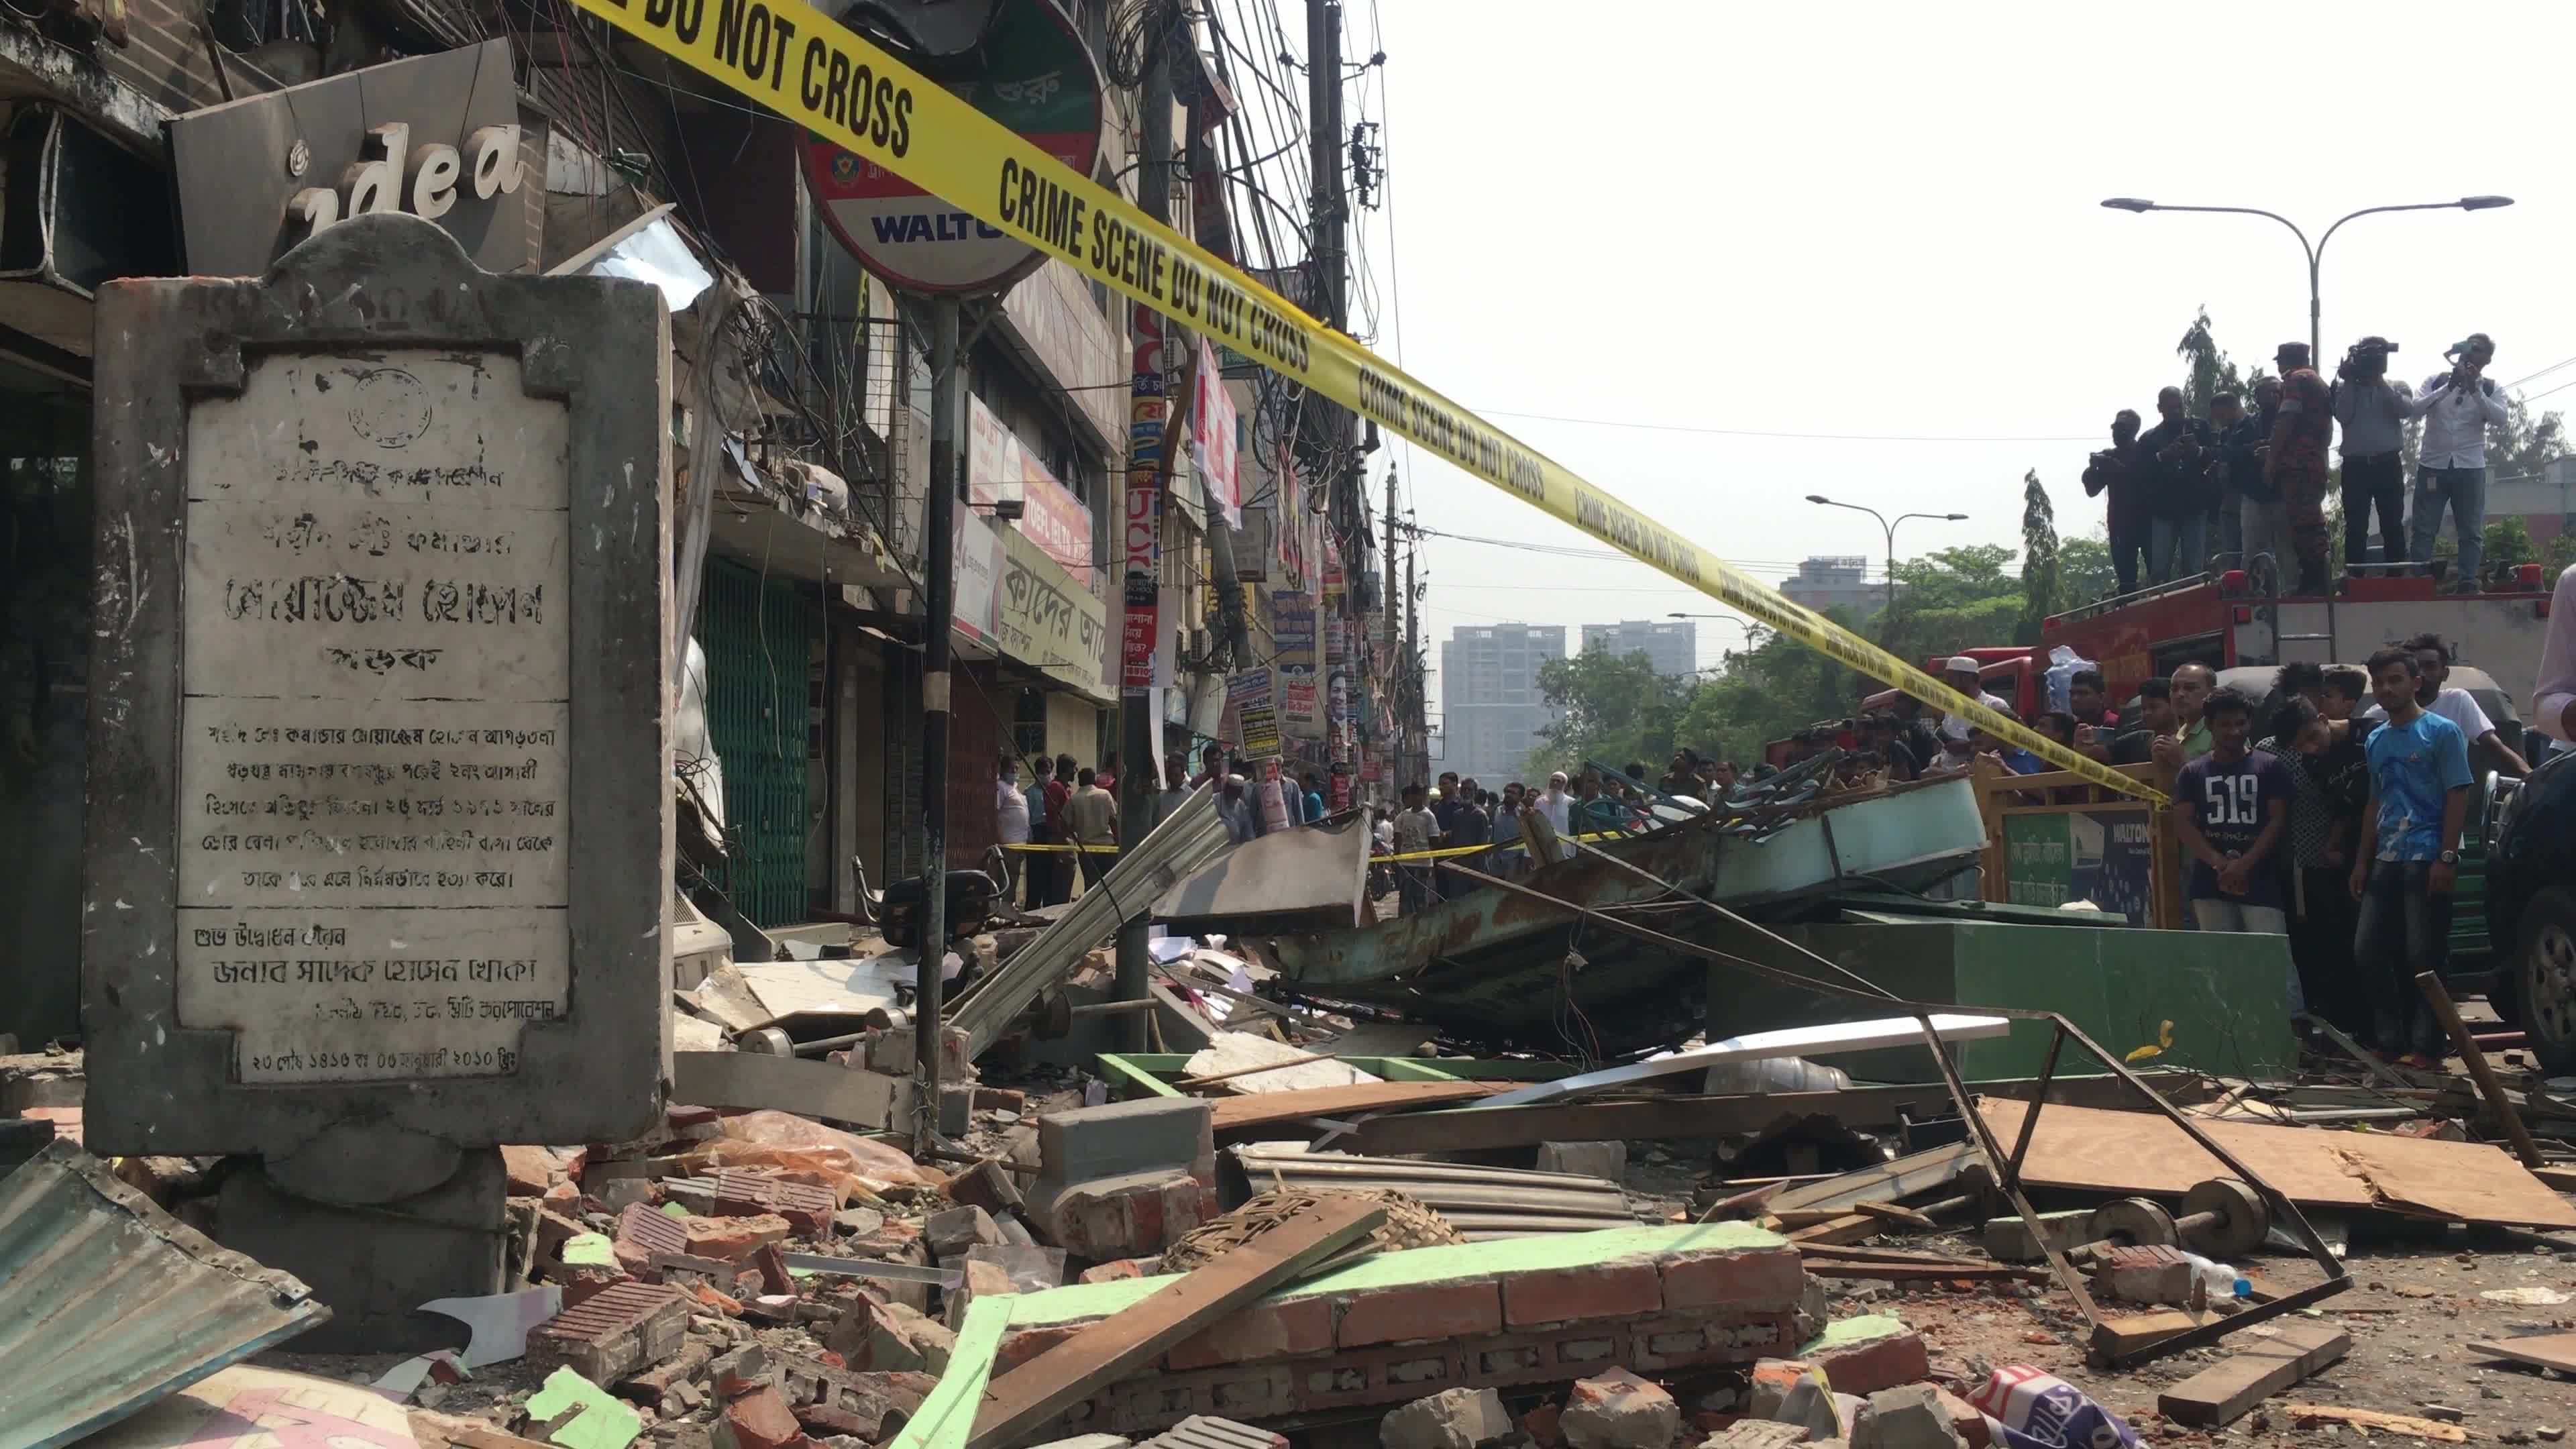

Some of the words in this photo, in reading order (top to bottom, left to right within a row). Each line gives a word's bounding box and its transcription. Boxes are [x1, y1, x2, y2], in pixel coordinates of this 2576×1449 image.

[714, 0, 796, 91] NOT
[801, 37, 912, 158] CROSS
[1000, 158, 1085, 259] CRIME
[1091, 209, 1166, 301] SCENE
[1171, 255, 1200, 317] DO
[1206, 274, 1245, 340] NOT
[1250, 302, 1309, 373] CROSS
[1358, 366, 1407, 431] CRIME
[1411, 393, 1456, 458] SCENE
[1458, 421, 1477, 466] DO
[1480, 431, 1503, 480] NOT
[1507, 446, 1545, 502] CROSS
[1025, 493, 1051, 541] TOEFL
[424, 578, 543, 625] হোসেন
[1006, 554, 1077, 645] কাদের
[284, 728, 348, 745] কমান্ডার
[450, 762, 480, 781] ২নং
[484, 757, 538, 781] আসামী
[2204, 773, 2259, 825] 519
[241, 871, 282, 888] তাকে
[324, 871, 352, 887] এনে
[194, 928, 228, 947] শুভ
[233, 921, 295, 947] উদ্বোধন
[211, 960, 289, 984] জনাব
[296, 960, 377, 983] সাদেক
[384, 959, 463, 983] হোসেন
[468, 959, 537, 983] খোকা
[277, 1047, 304, 1071] পৌষ
[452, 1049, 494, 1067] ২০১০
